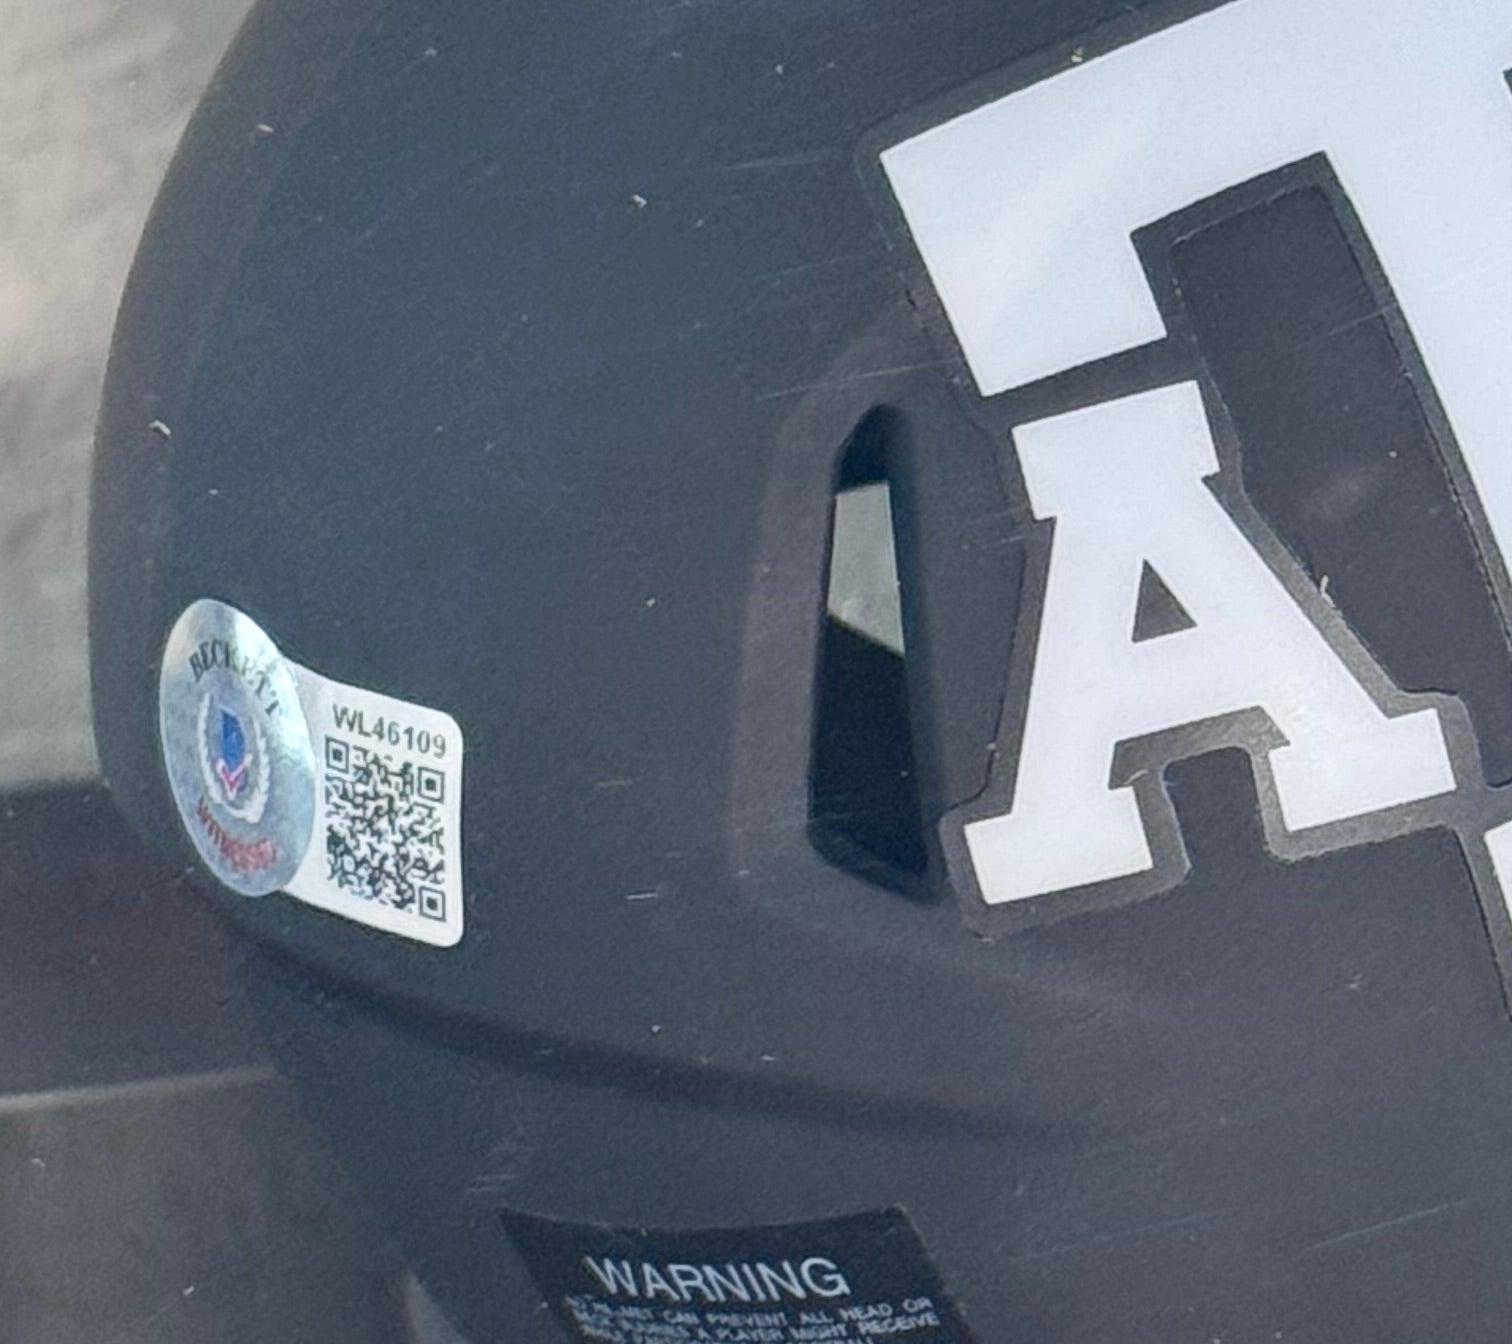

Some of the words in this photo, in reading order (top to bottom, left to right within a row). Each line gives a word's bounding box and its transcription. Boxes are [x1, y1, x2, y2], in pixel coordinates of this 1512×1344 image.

[331, 702, 448, 759] WL46109
[584, 1255, 852, 1302] WARNING
[799, 1311, 834, 1325] ALL
[838, 1303, 893, 1322] HEAD
[902, 1297, 934, 1313] OR
[857, 1311, 940, 1335] RECEIVE
